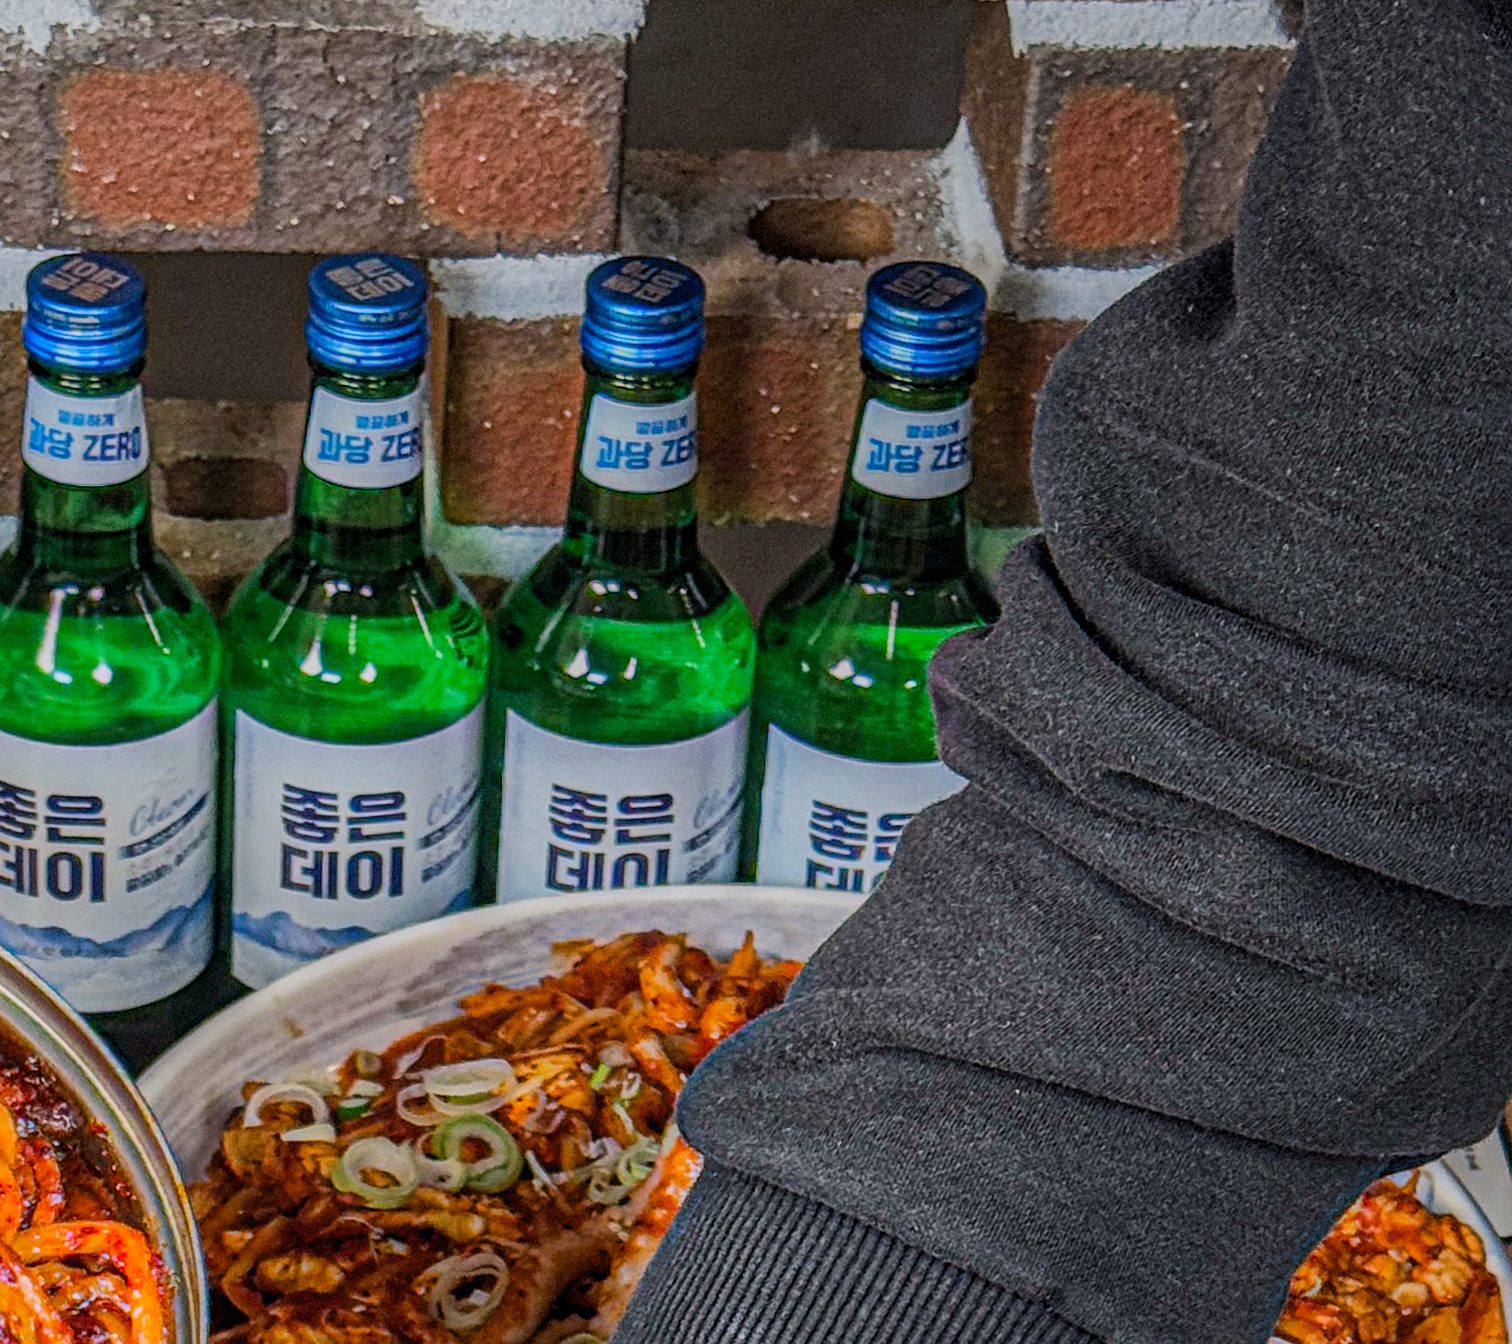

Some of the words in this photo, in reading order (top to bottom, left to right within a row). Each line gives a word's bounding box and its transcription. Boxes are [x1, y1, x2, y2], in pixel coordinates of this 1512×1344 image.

[29, 416, 74, 460] 과당
[82, 425, 141, 462] ZERO
[317, 427, 373, 465] 과당
[381, 426, 421, 463] ZE
[596, 434, 653, 470] 과당
[660, 431, 695, 468] ZE
[866, 437, 923, 474] 과당
[930, 436, 968, 473] ZE
[280, 782, 407, 845] 좋은
[548, 782, 675, 846] 좋은
[280, 843, 405, 900] 데이
[545, 843, 672, 892] 데이
[806, 857, 886, 893] 데
